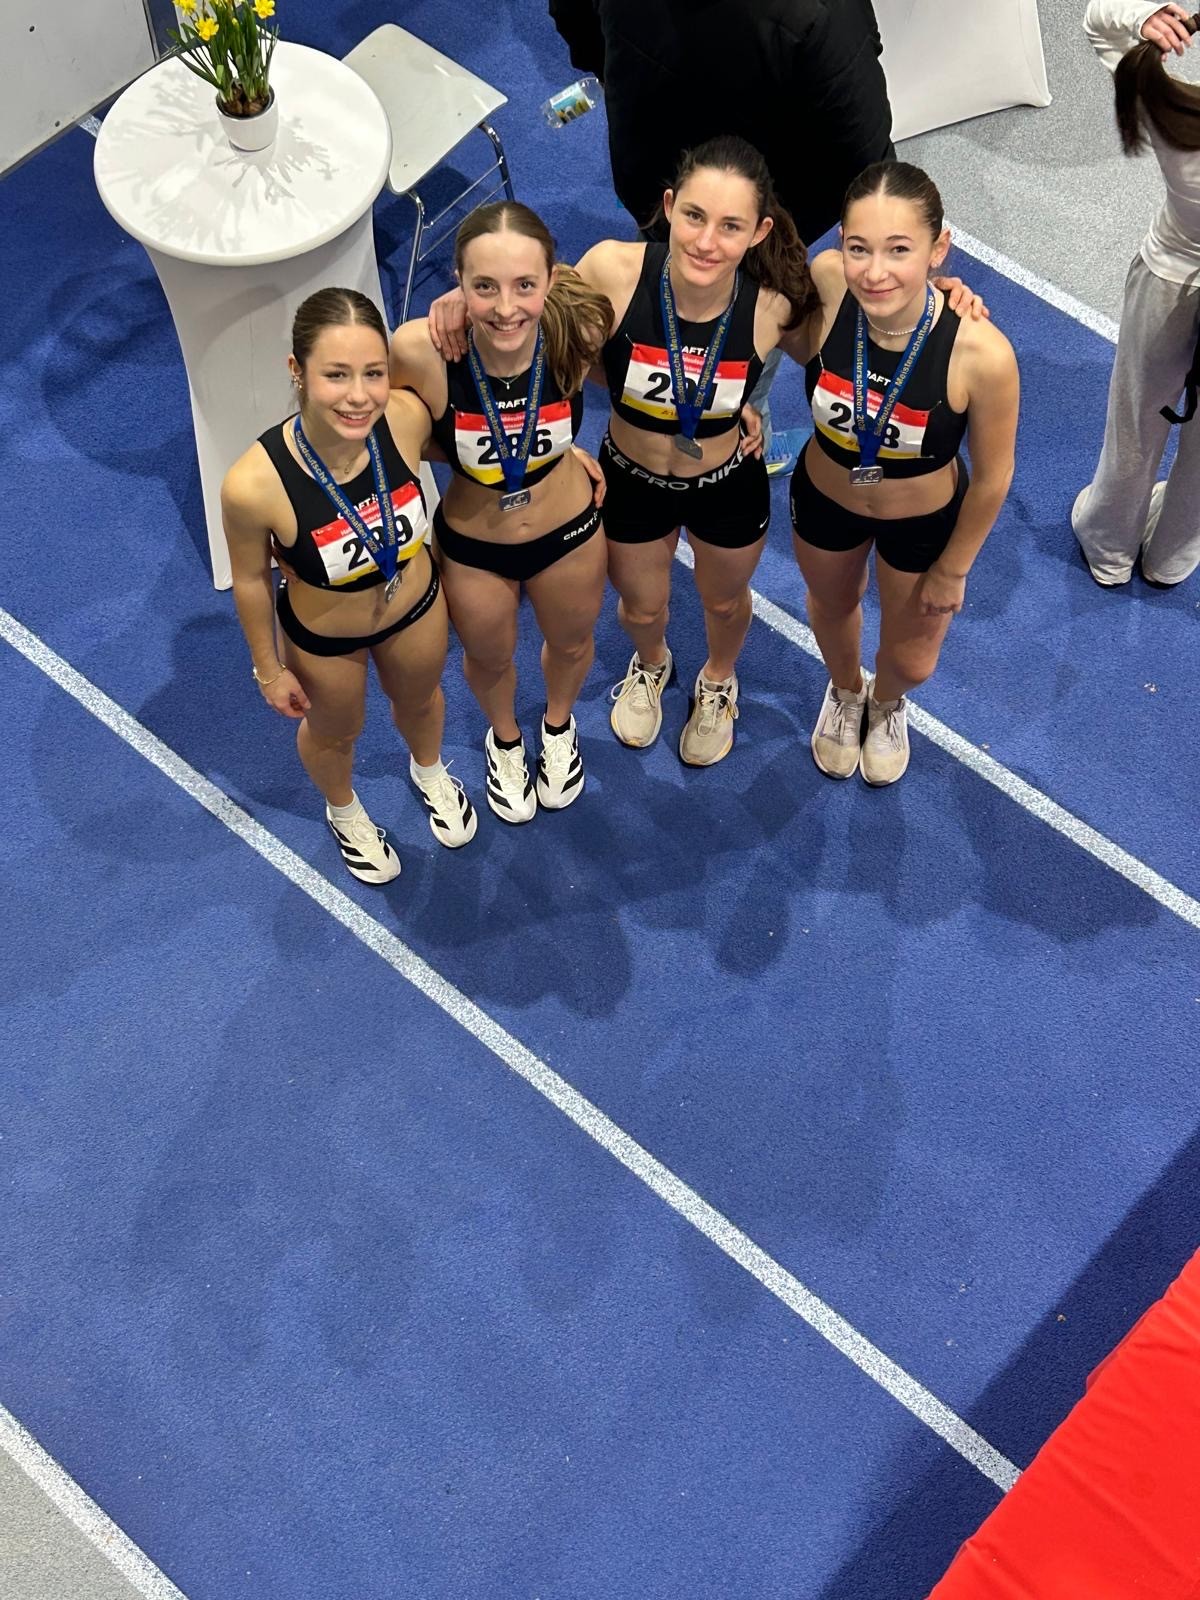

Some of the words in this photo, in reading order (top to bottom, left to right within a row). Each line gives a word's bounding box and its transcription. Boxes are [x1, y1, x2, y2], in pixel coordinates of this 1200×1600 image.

[894, 318, 930, 386] Meisterschaften
[496, 398, 527, 409] RAFT
[631, 467, 690, 490] PRO
[324, 482, 368, 539] Meisterschaften
[564, 517, 594, 540] CRAFT
